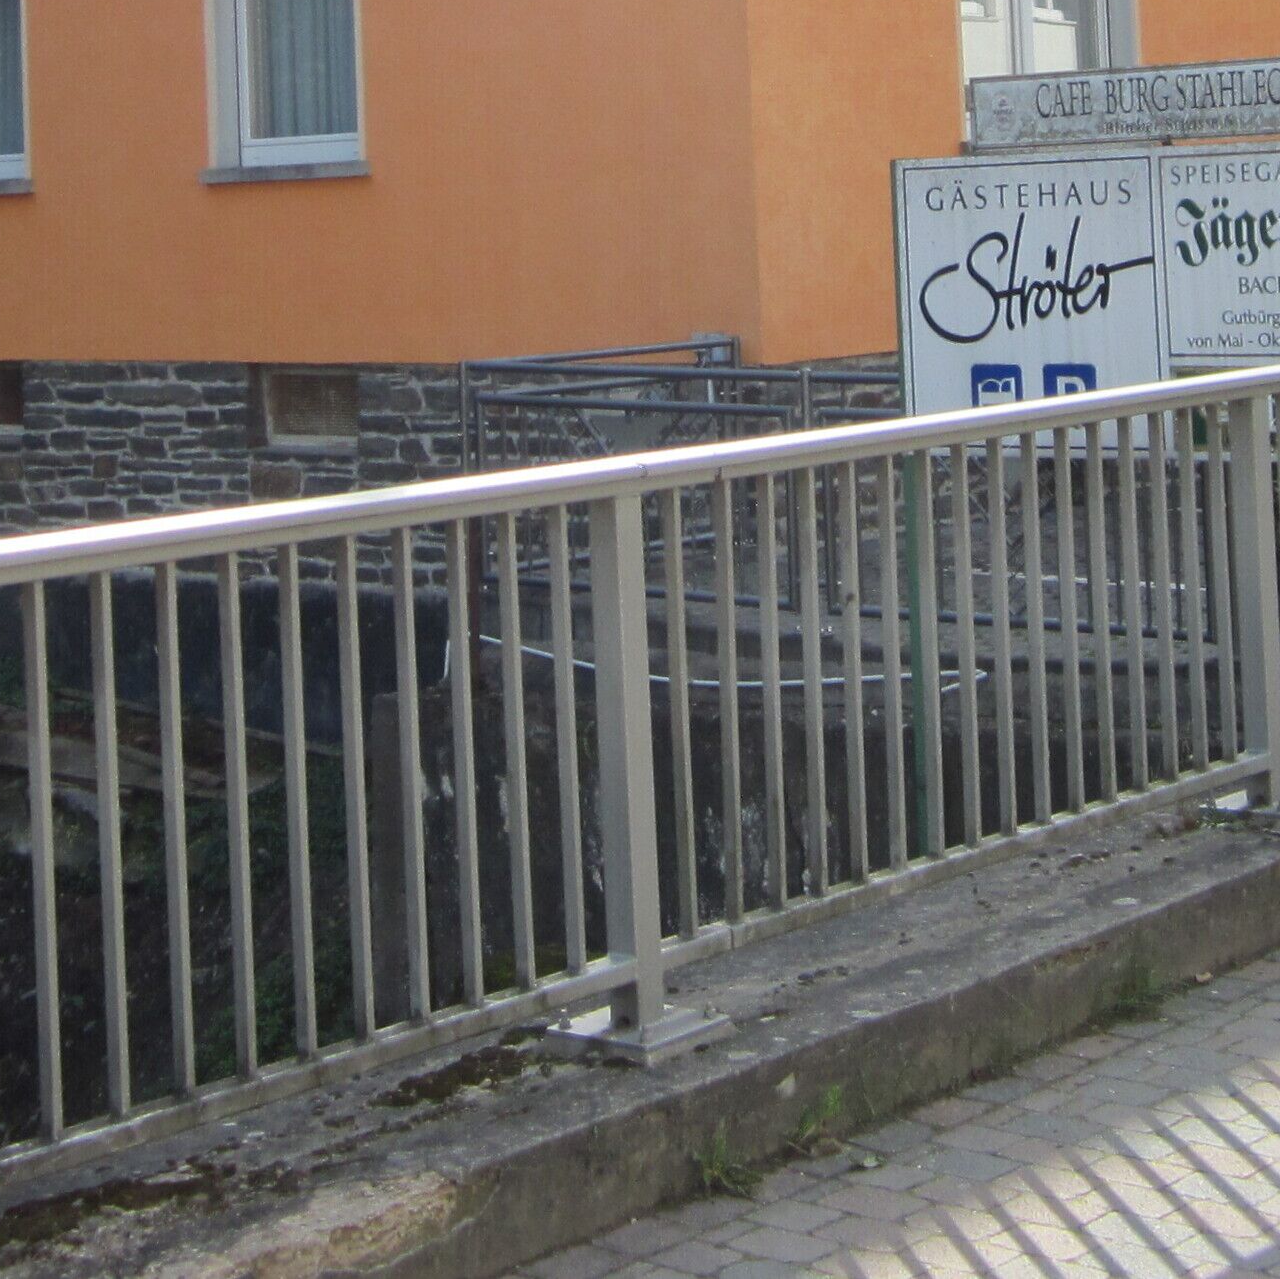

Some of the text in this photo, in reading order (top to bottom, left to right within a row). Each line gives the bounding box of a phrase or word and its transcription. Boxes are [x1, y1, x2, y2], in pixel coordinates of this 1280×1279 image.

[1036, 80, 1093, 119] CAFE
[1104, 75, 1169, 117] BURG
[925, 179, 1132, 212] GÄSTEHAUS
[1186, 337, 1213, 348] von
[1219, 333, 1244, 348] Mai
